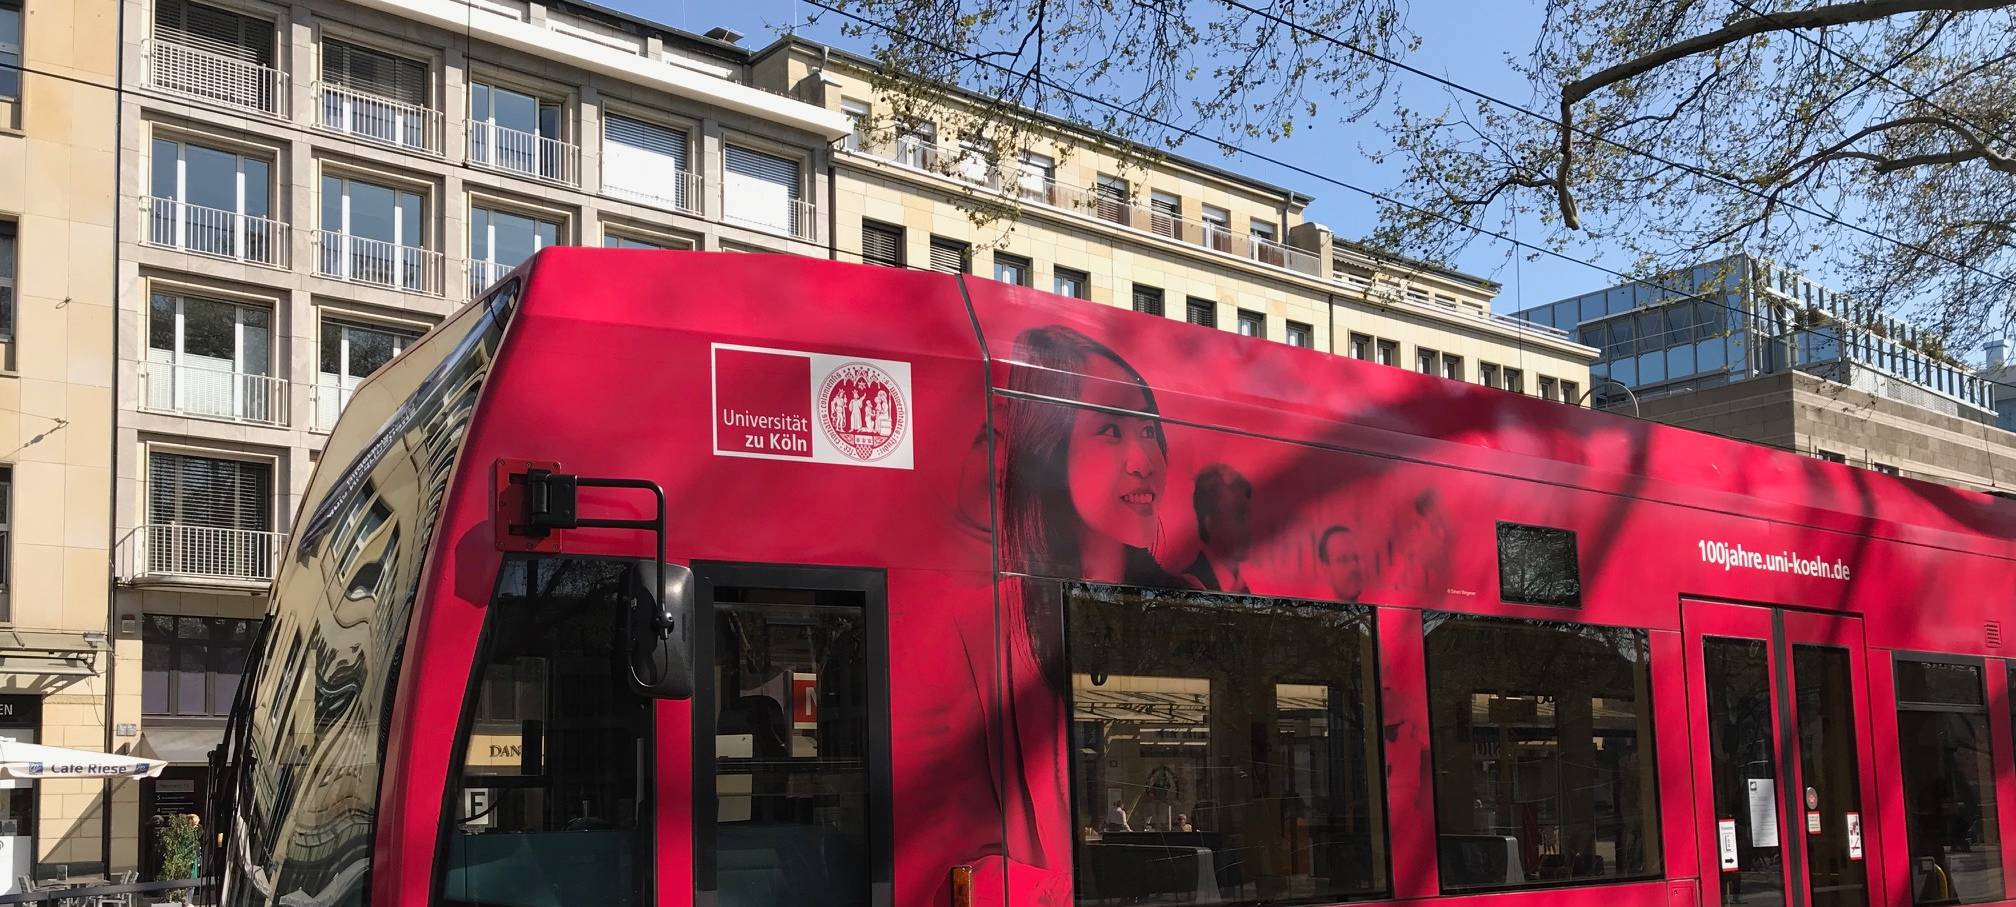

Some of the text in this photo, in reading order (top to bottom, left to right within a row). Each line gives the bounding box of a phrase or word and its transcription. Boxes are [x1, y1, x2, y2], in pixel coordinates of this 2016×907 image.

[723, 409, 808, 432] Universität
[745, 432, 808, 452] zu Köln
[1698, 539, 1851, 581] 100jahre.uni-koeln.de
[87, 763, 127, 774] Riese
